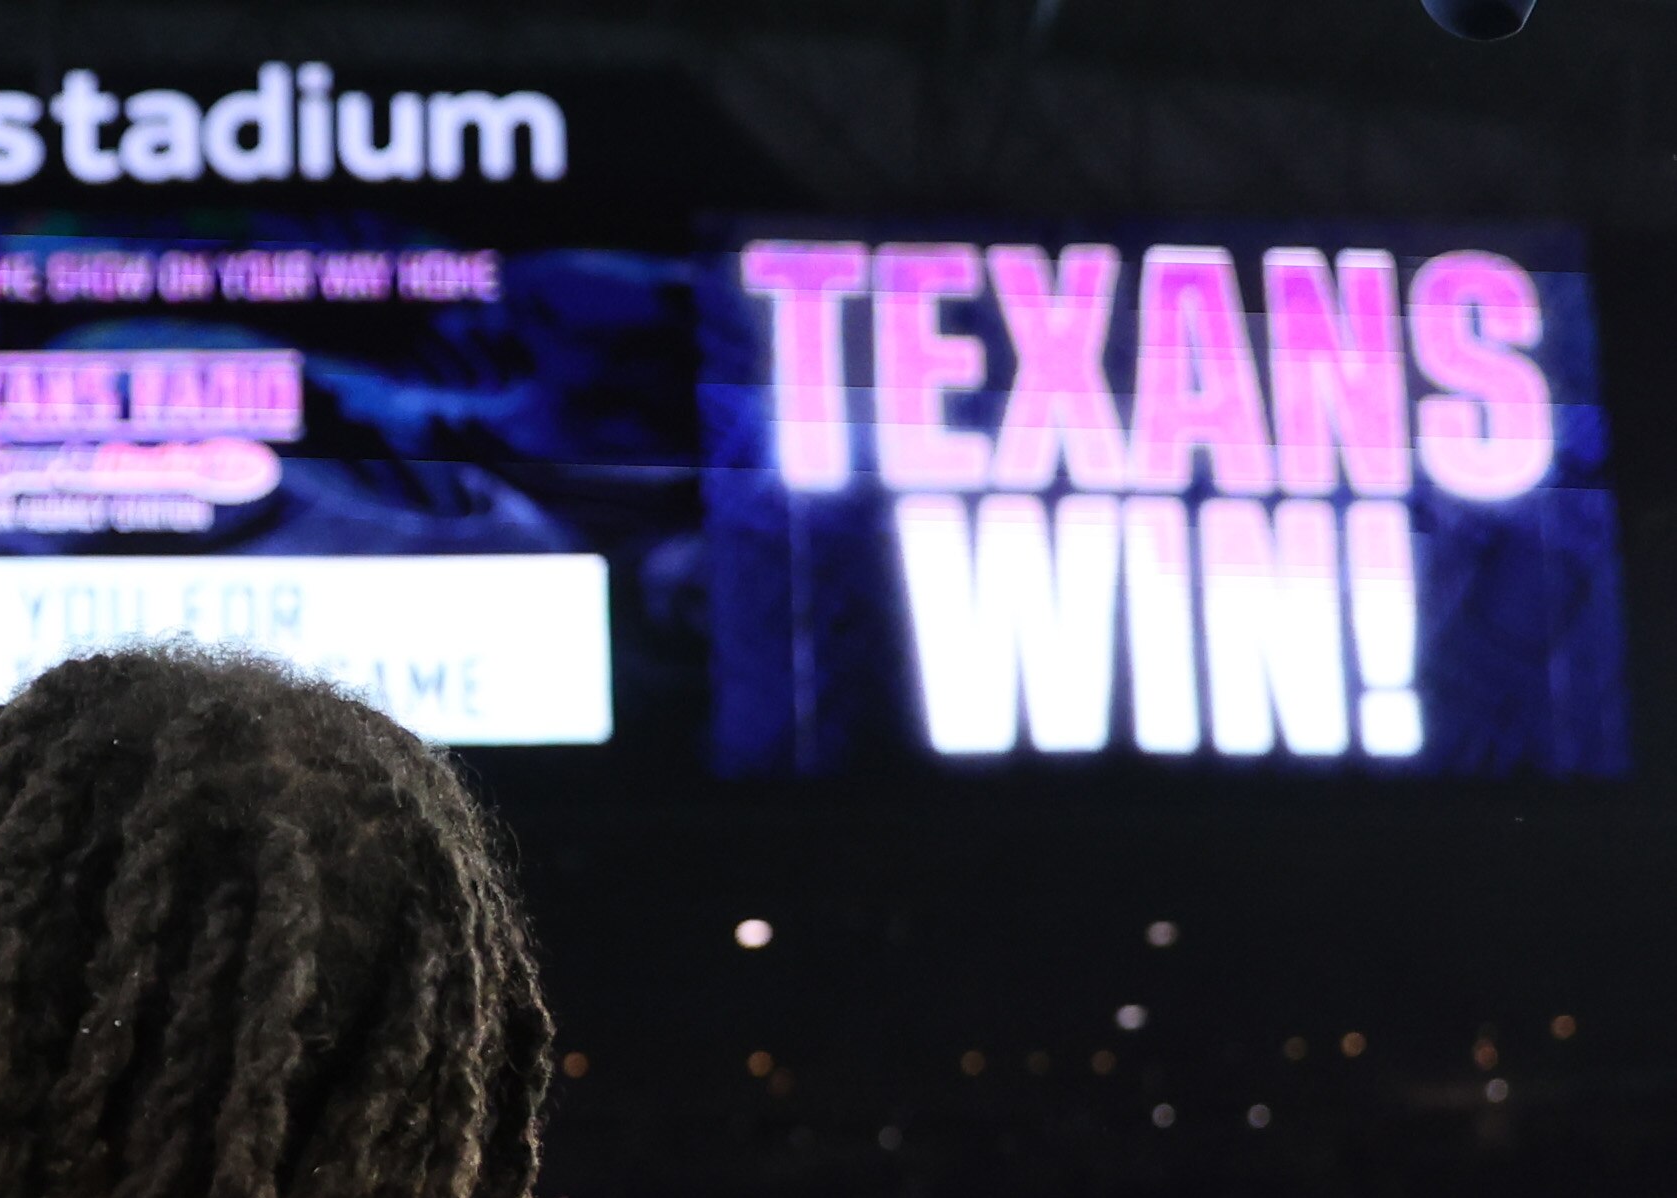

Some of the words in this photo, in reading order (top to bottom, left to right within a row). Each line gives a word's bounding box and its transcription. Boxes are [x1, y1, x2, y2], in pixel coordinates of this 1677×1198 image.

[740, 240, 1554, 501] TEXANS
[23, 582, 146, 641] YOU
[181, 580, 306, 641] FOR
[896, 493, 1424, 758] WIN!
